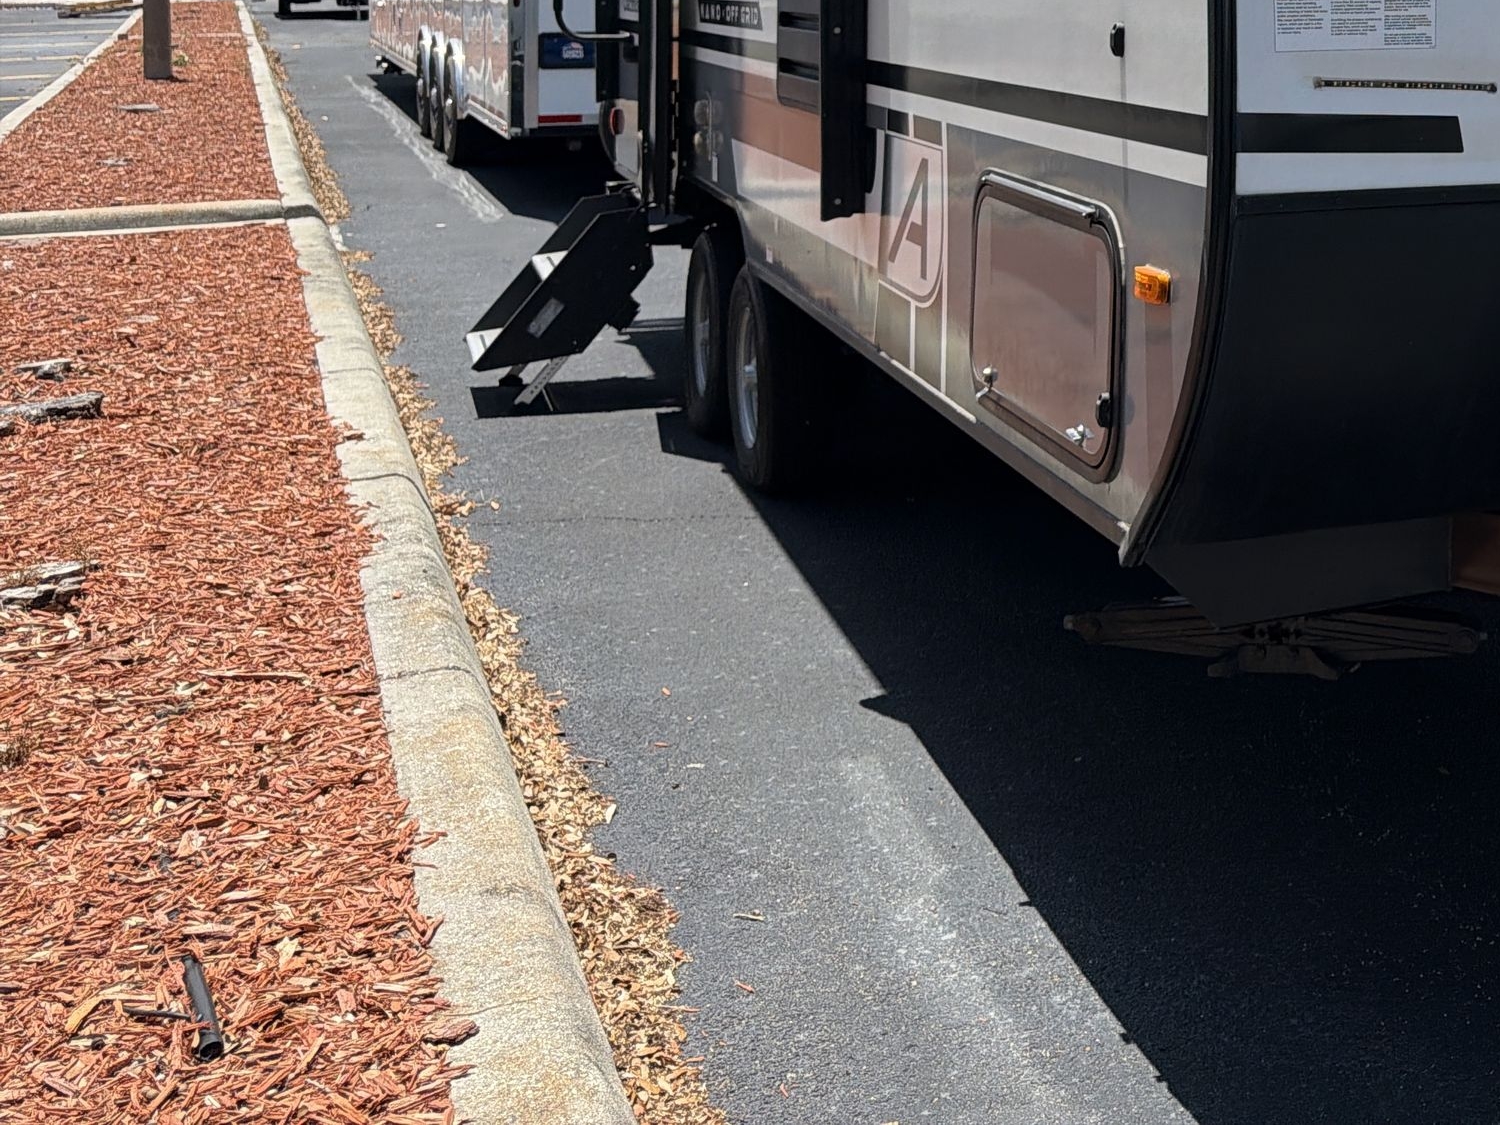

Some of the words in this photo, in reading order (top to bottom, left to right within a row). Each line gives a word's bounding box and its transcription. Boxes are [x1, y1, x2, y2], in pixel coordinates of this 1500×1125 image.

[700, 3, 721, 21] NANO
[726, 5, 739, 23] OFF
[741, 6, 759, 25] GRID
